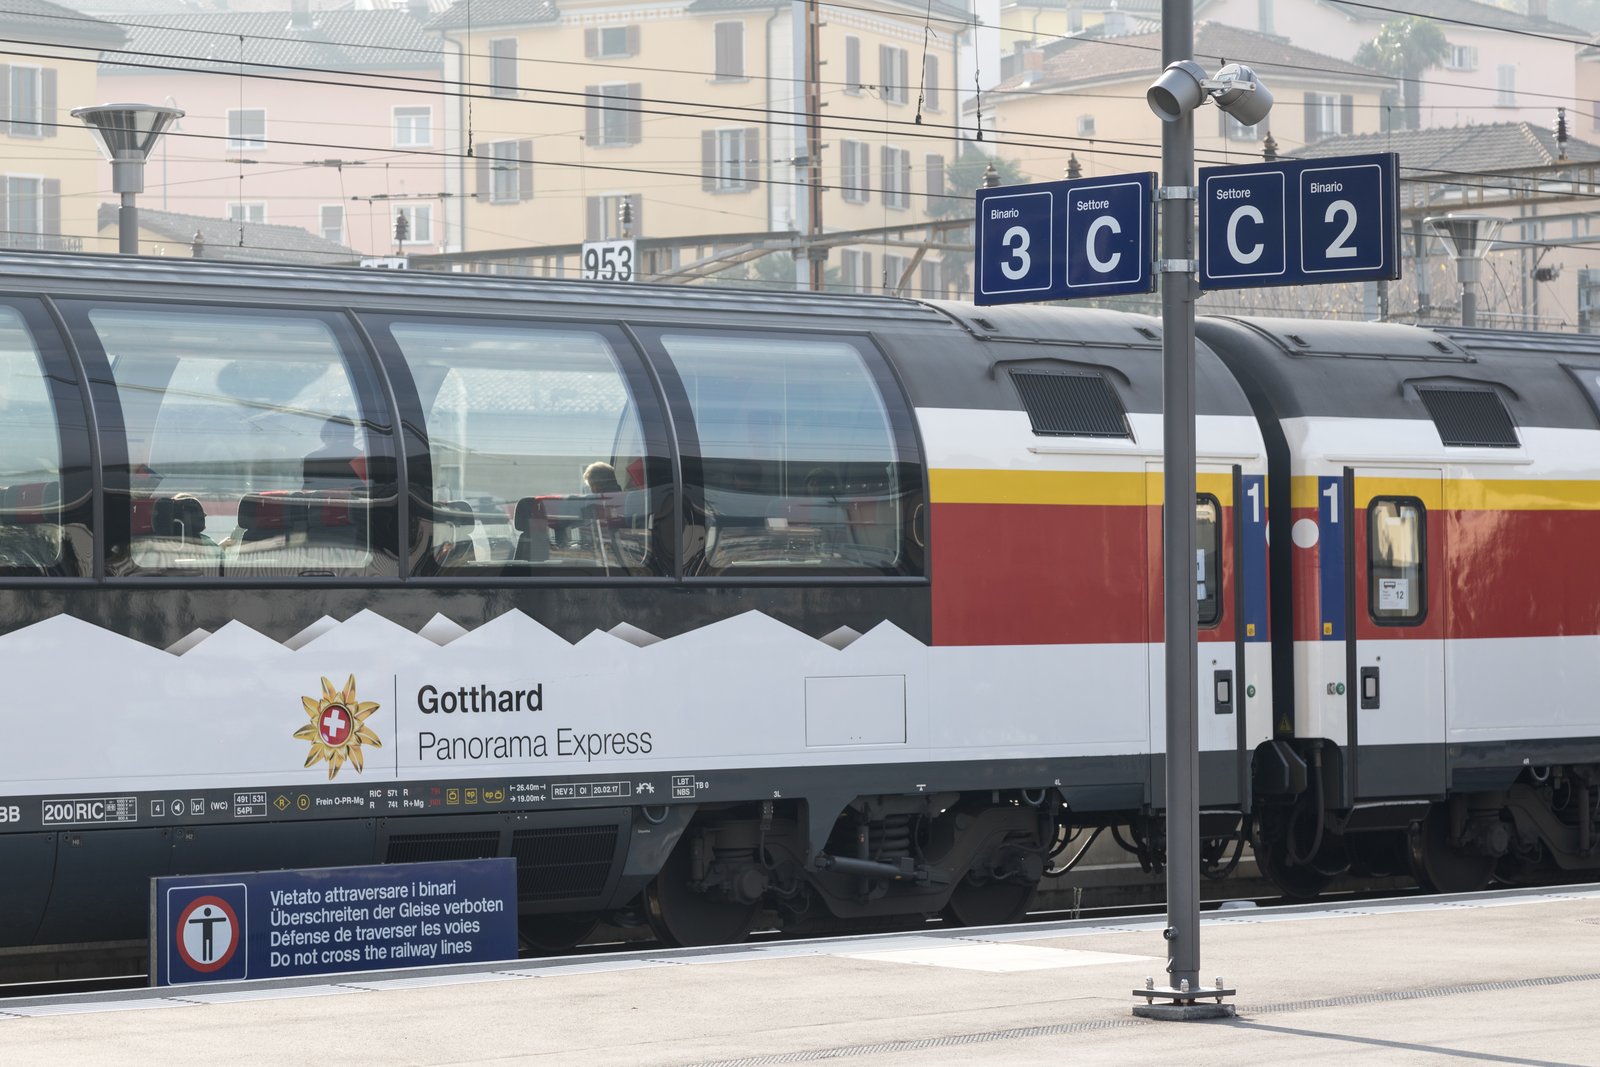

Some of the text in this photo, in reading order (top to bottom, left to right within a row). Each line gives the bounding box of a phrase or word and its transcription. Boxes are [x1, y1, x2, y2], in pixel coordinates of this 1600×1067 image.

[1216, 188, 1250, 200] Settore
[1310, 181, 1343, 193] Binario
[1076, 200, 1109, 211] Settore
[991, 208, 1019, 220] Binario
[1226, 204, 1264, 264] C
[1324, 199, 1357, 258] 2
[1086, 215, 1122, 273] C
[1001, 225, 1031, 280] 3
[584, 245, 632, 281] 953
[1247, 483, 1259, 523] 1
[1323, 483, 1338, 523] 1
[1396, 591, 1404, 600] 12
[417, 683, 543, 714] Gotthard
[418, 727, 653, 762] Panorama Express
[369, 789, 398, 798] RIC 57t
[403, 788, 409, 796] R
[554, 787, 573, 796] REV 2
[593, 785, 619, 794] 20.02.17
[676, 788, 690, 796] NBS
[210, 800, 228, 811] (WC)
[236, 795, 248, 803] 49t
[316, 797, 333, 806] Frein
[369, 801, 375, 809] R
[403, 799, 424, 809] R+Mg
[44, 803, 74, 821] 200
[76, 802, 104, 820] RIC
[270, 880, 457, 906] Vietato attraversare i binari
[270, 898, 504, 927] Überschreiten der Gleise verboten
[270, 919, 480, 947] Défense de traverser les voies
[270, 939, 472, 967] Do not cross the railway lines
